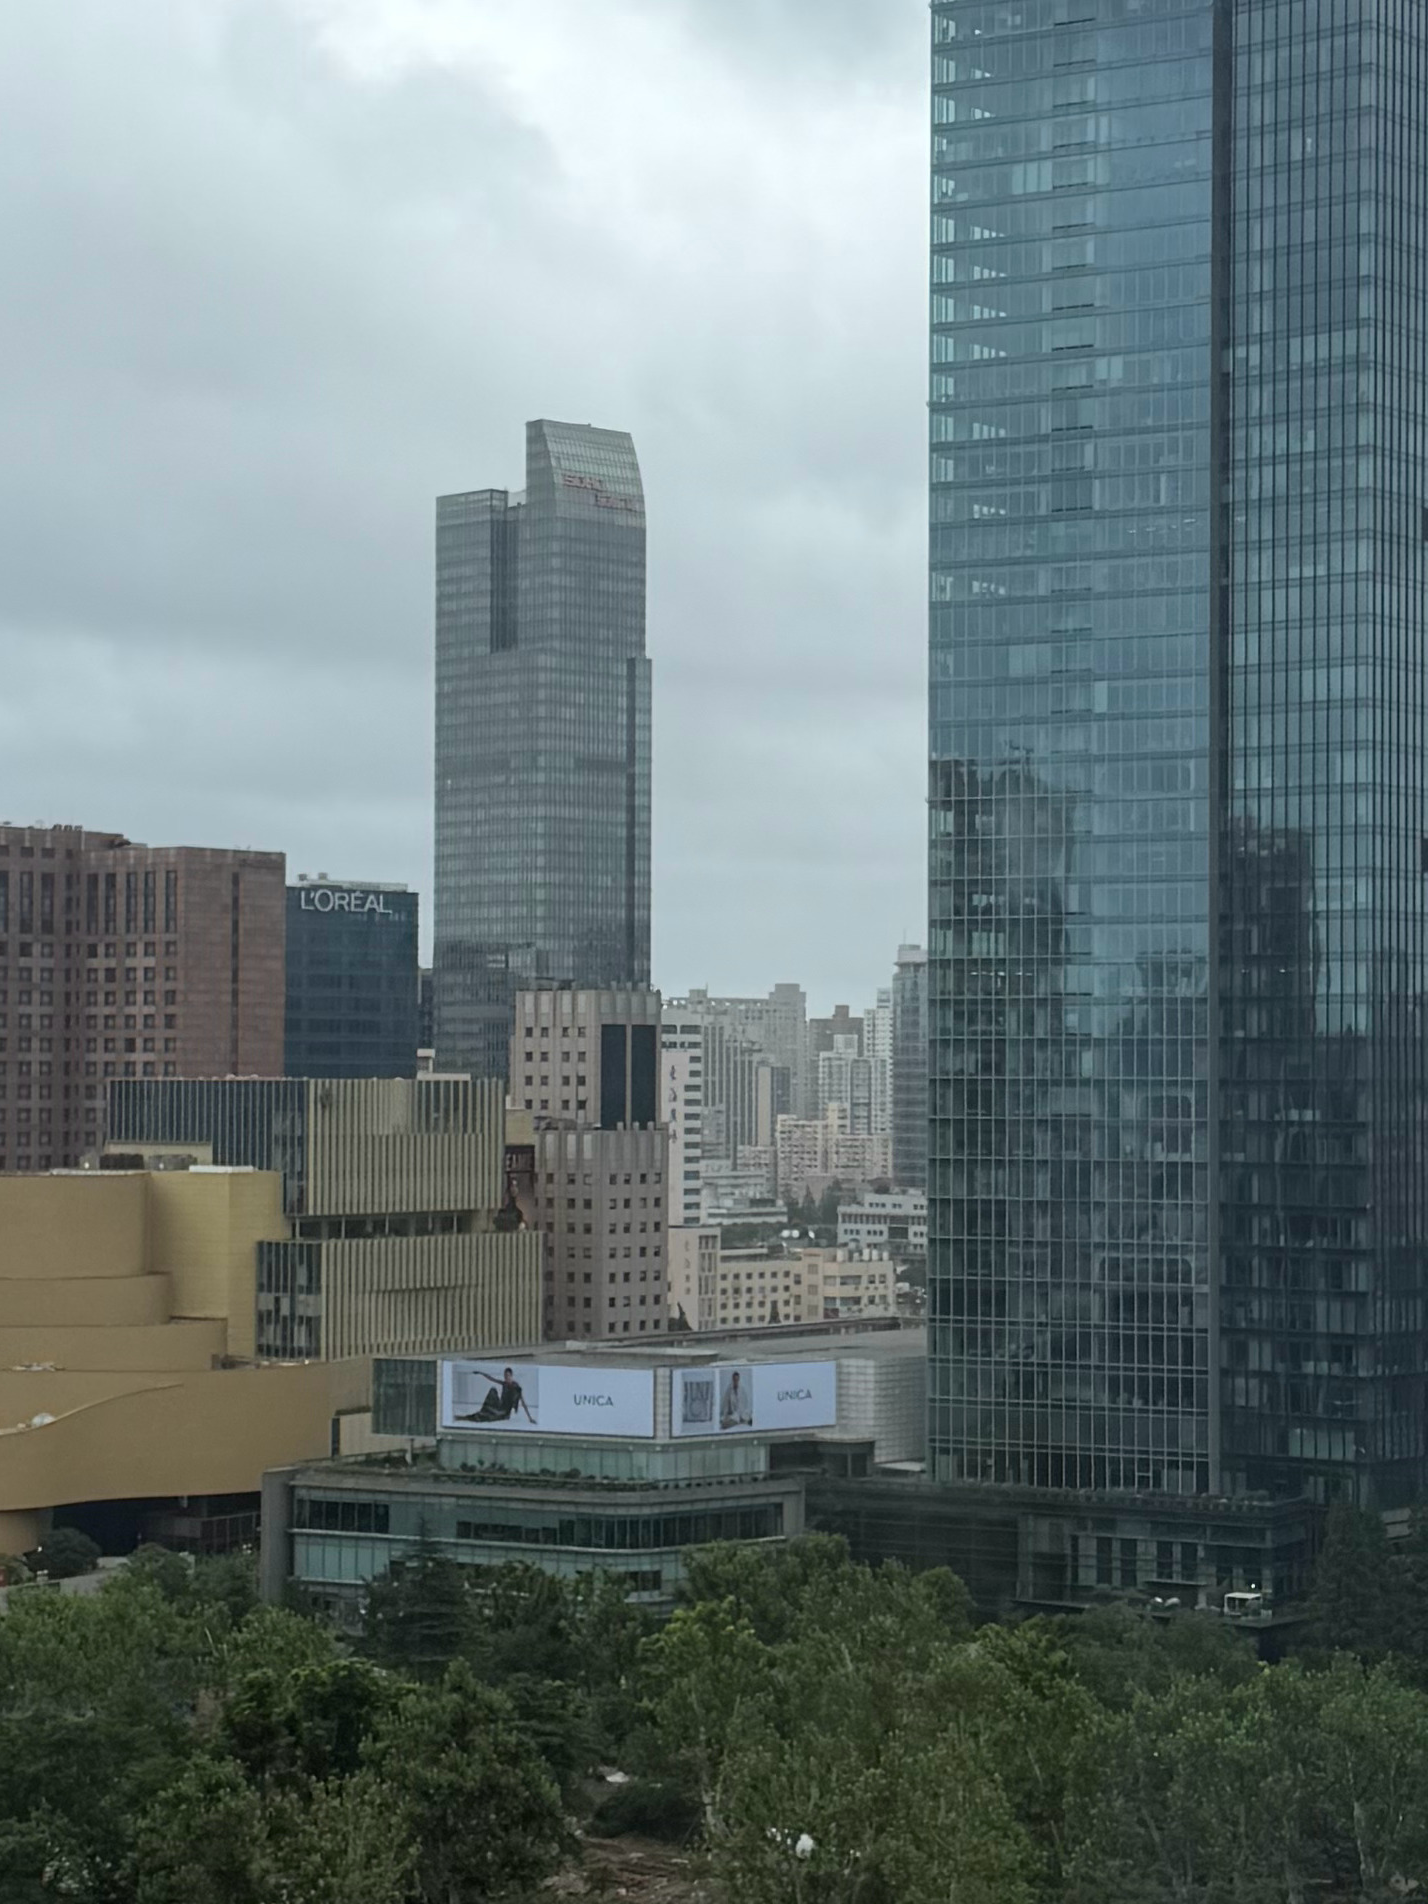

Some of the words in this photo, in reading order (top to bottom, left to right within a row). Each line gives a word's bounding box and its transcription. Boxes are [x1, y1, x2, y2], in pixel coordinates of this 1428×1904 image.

[300, 889, 393, 914] L'ORÉAL
[574, 1394, 614, 1407] UNICA
[777, 1389, 812, 1402] UNICA
